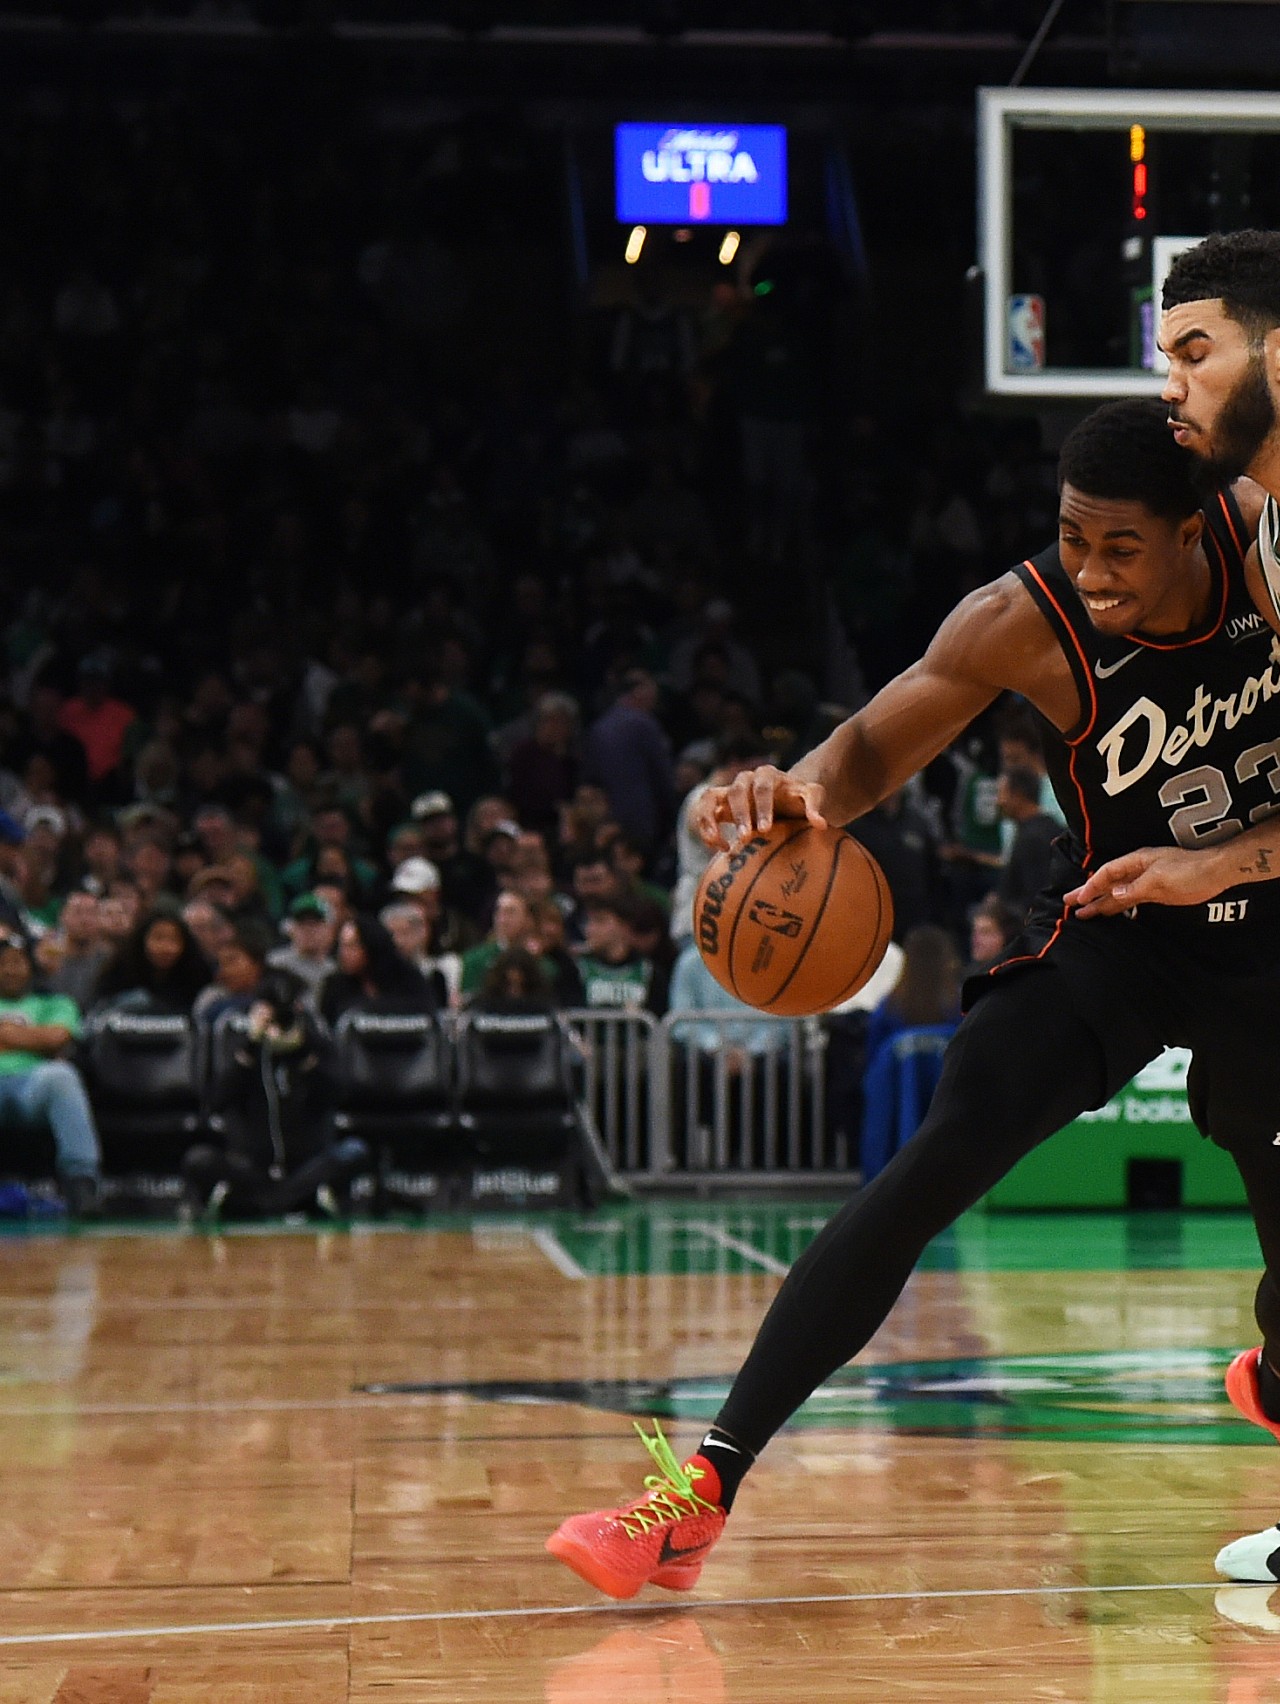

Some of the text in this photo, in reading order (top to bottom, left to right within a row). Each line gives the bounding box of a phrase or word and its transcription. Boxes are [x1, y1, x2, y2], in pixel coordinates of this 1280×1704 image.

[642, 150, 759, 183] ULTRA
[700, 837, 770, 954] Wilson
[1207, 899, 1249, 923] DET
